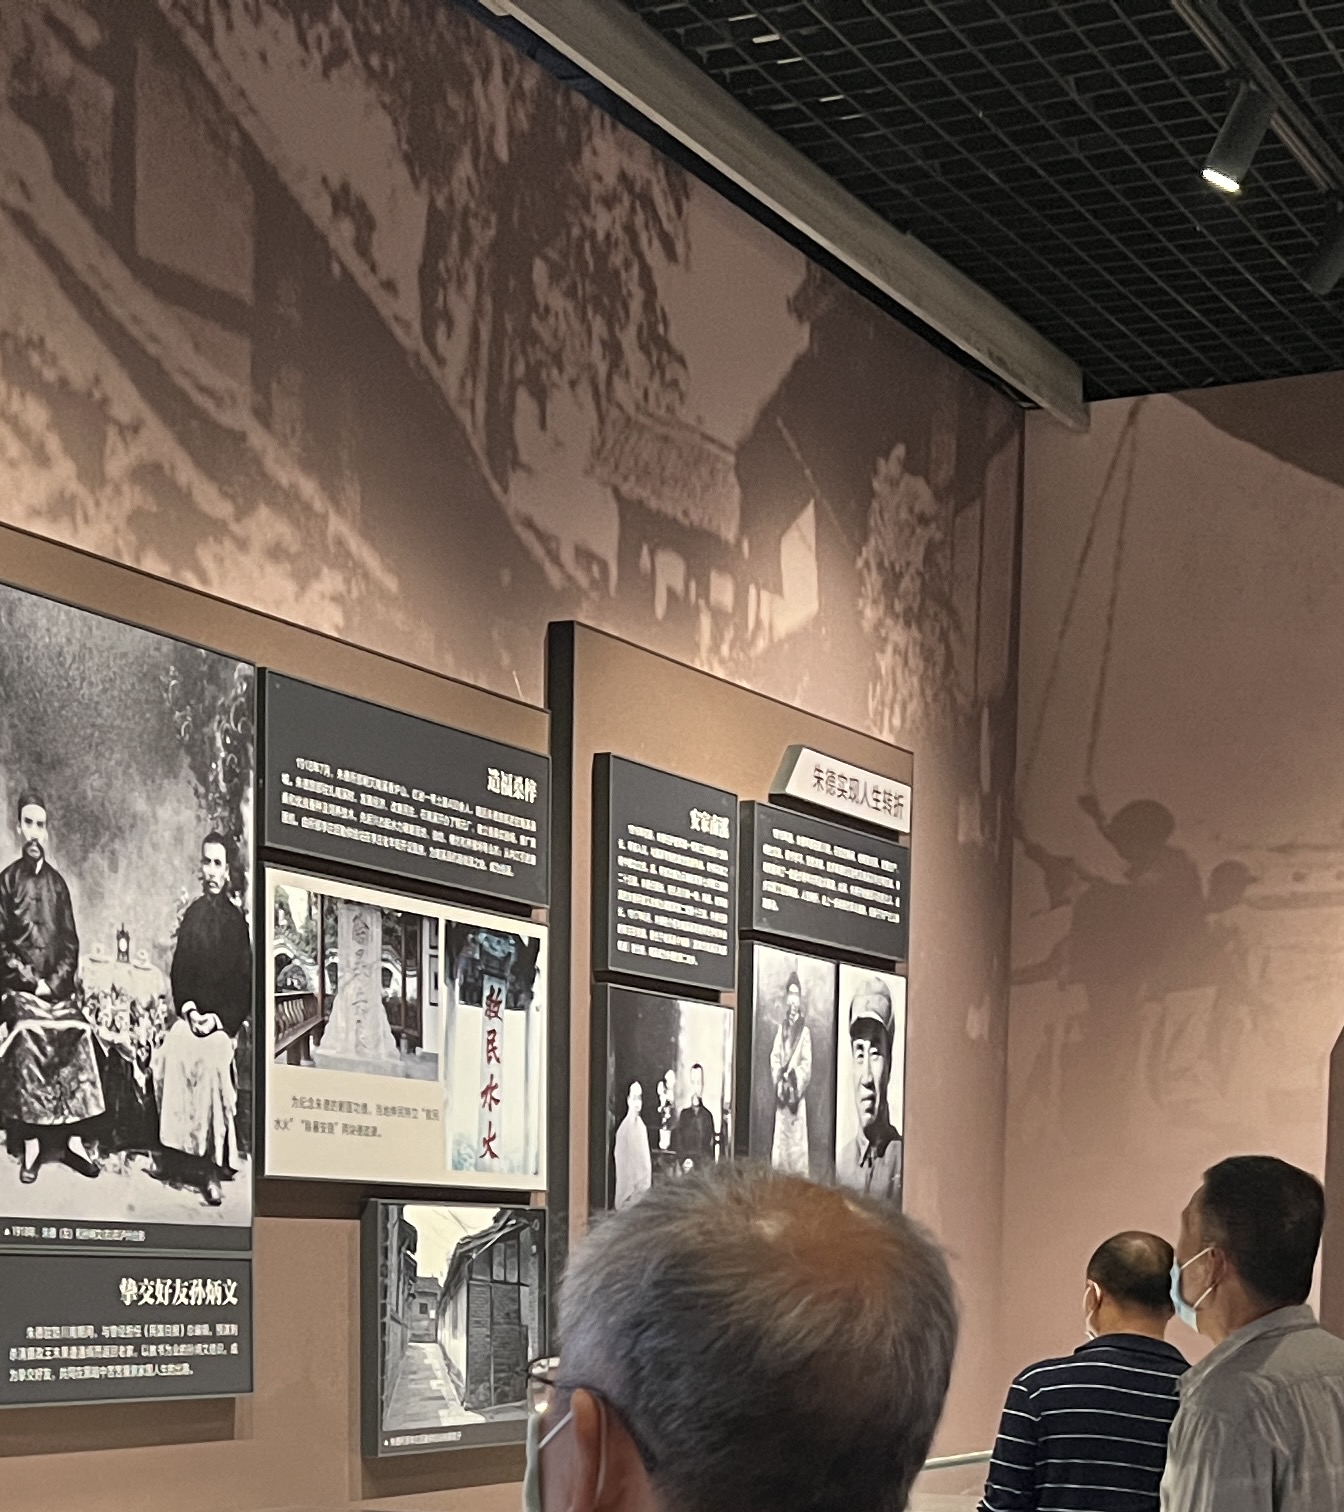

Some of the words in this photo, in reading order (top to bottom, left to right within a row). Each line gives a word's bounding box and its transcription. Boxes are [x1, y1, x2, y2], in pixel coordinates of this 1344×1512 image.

[813, 764, 905, 819] 朱德实现人生转折
